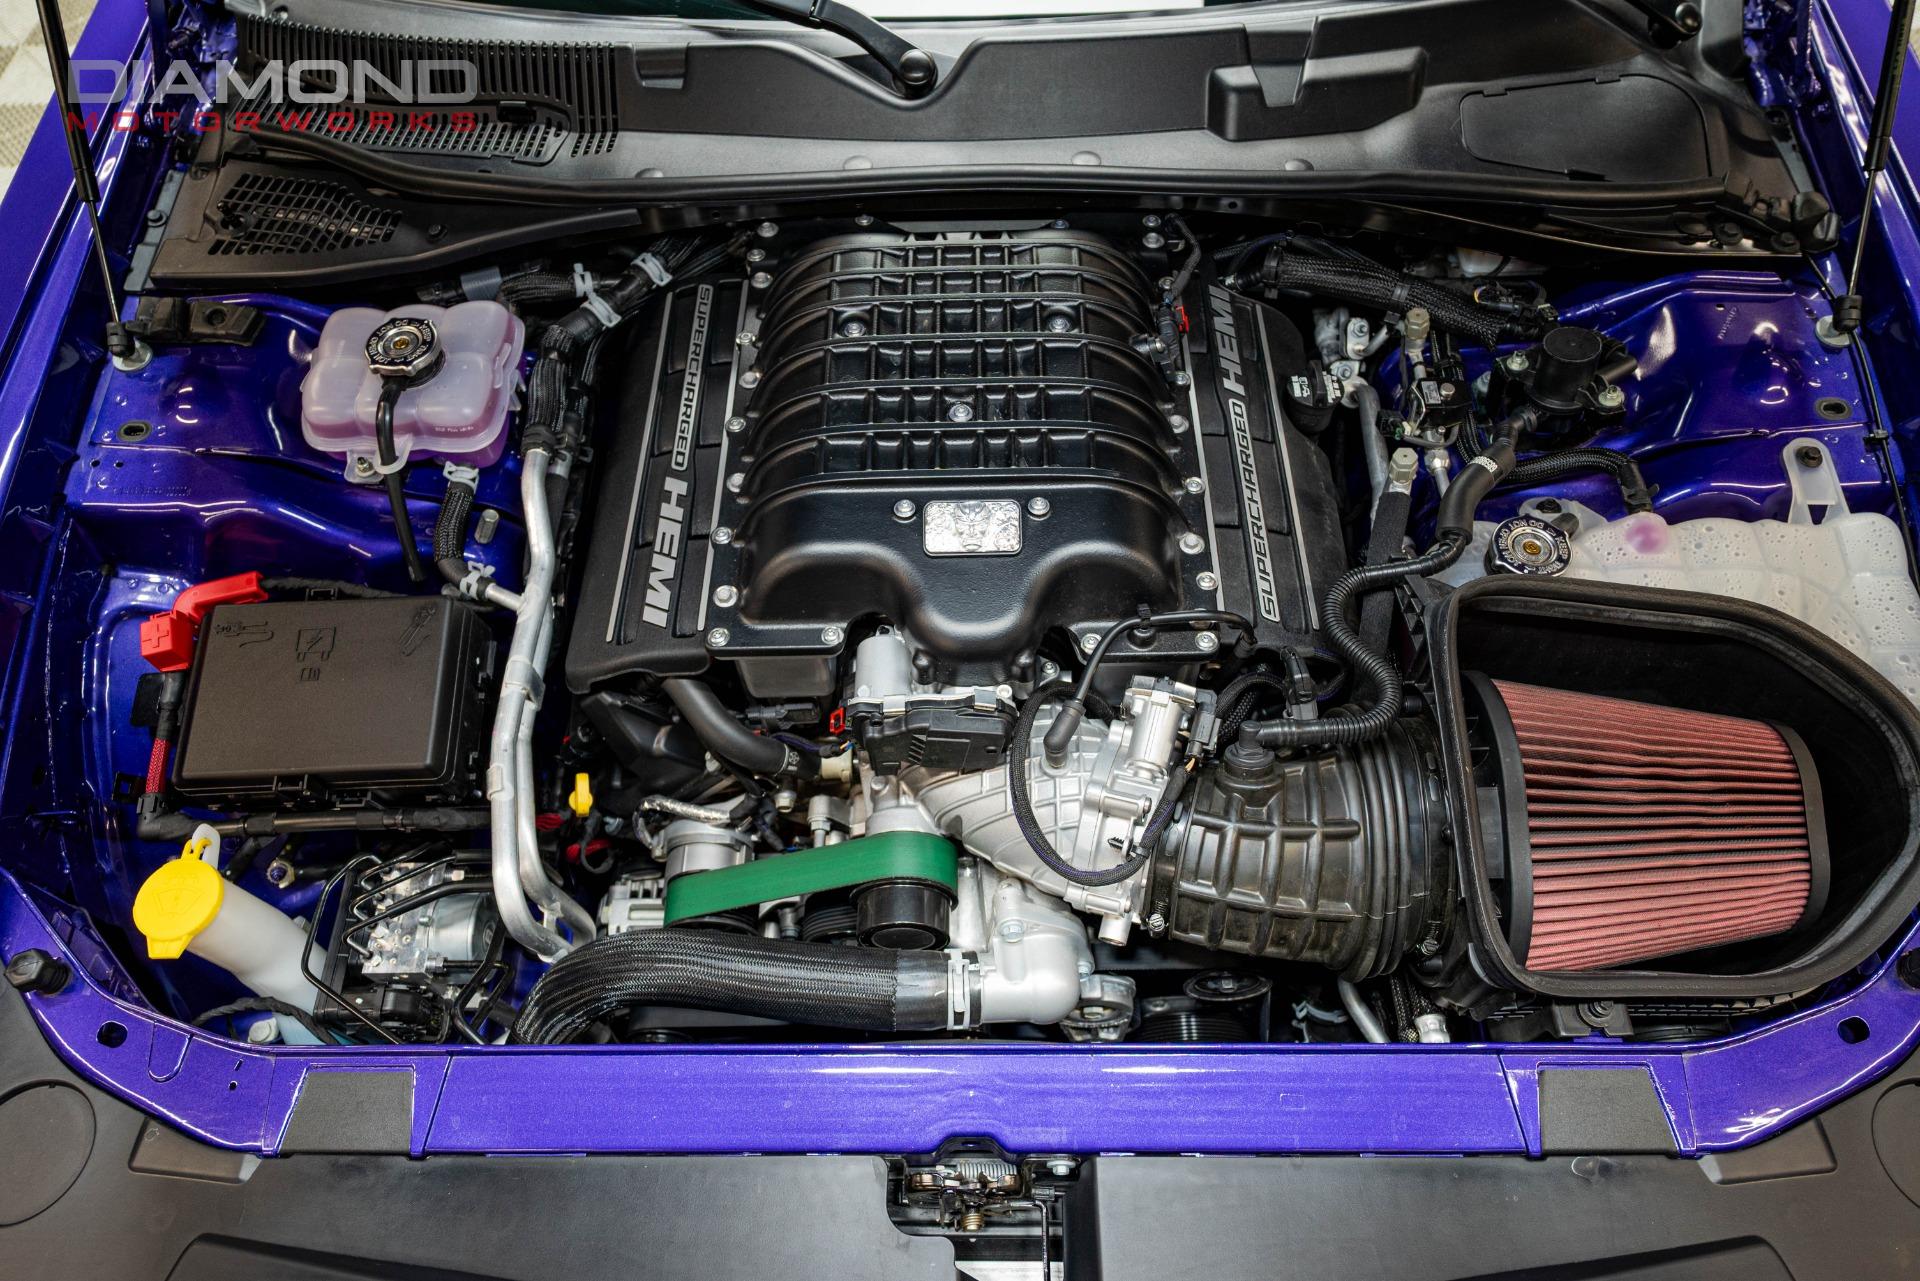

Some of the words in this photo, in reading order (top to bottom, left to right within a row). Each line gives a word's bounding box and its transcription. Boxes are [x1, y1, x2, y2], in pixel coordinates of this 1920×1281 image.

[671, 283, 714, 471] SUPERCHARGED
[1208, 285, 1248, 397] HEMI
[642, 476, 689, 628] HEMI
[1228, 397, 1281, 622] SUPERCHARGED
[1508, 518, 1528, 531] NOT
